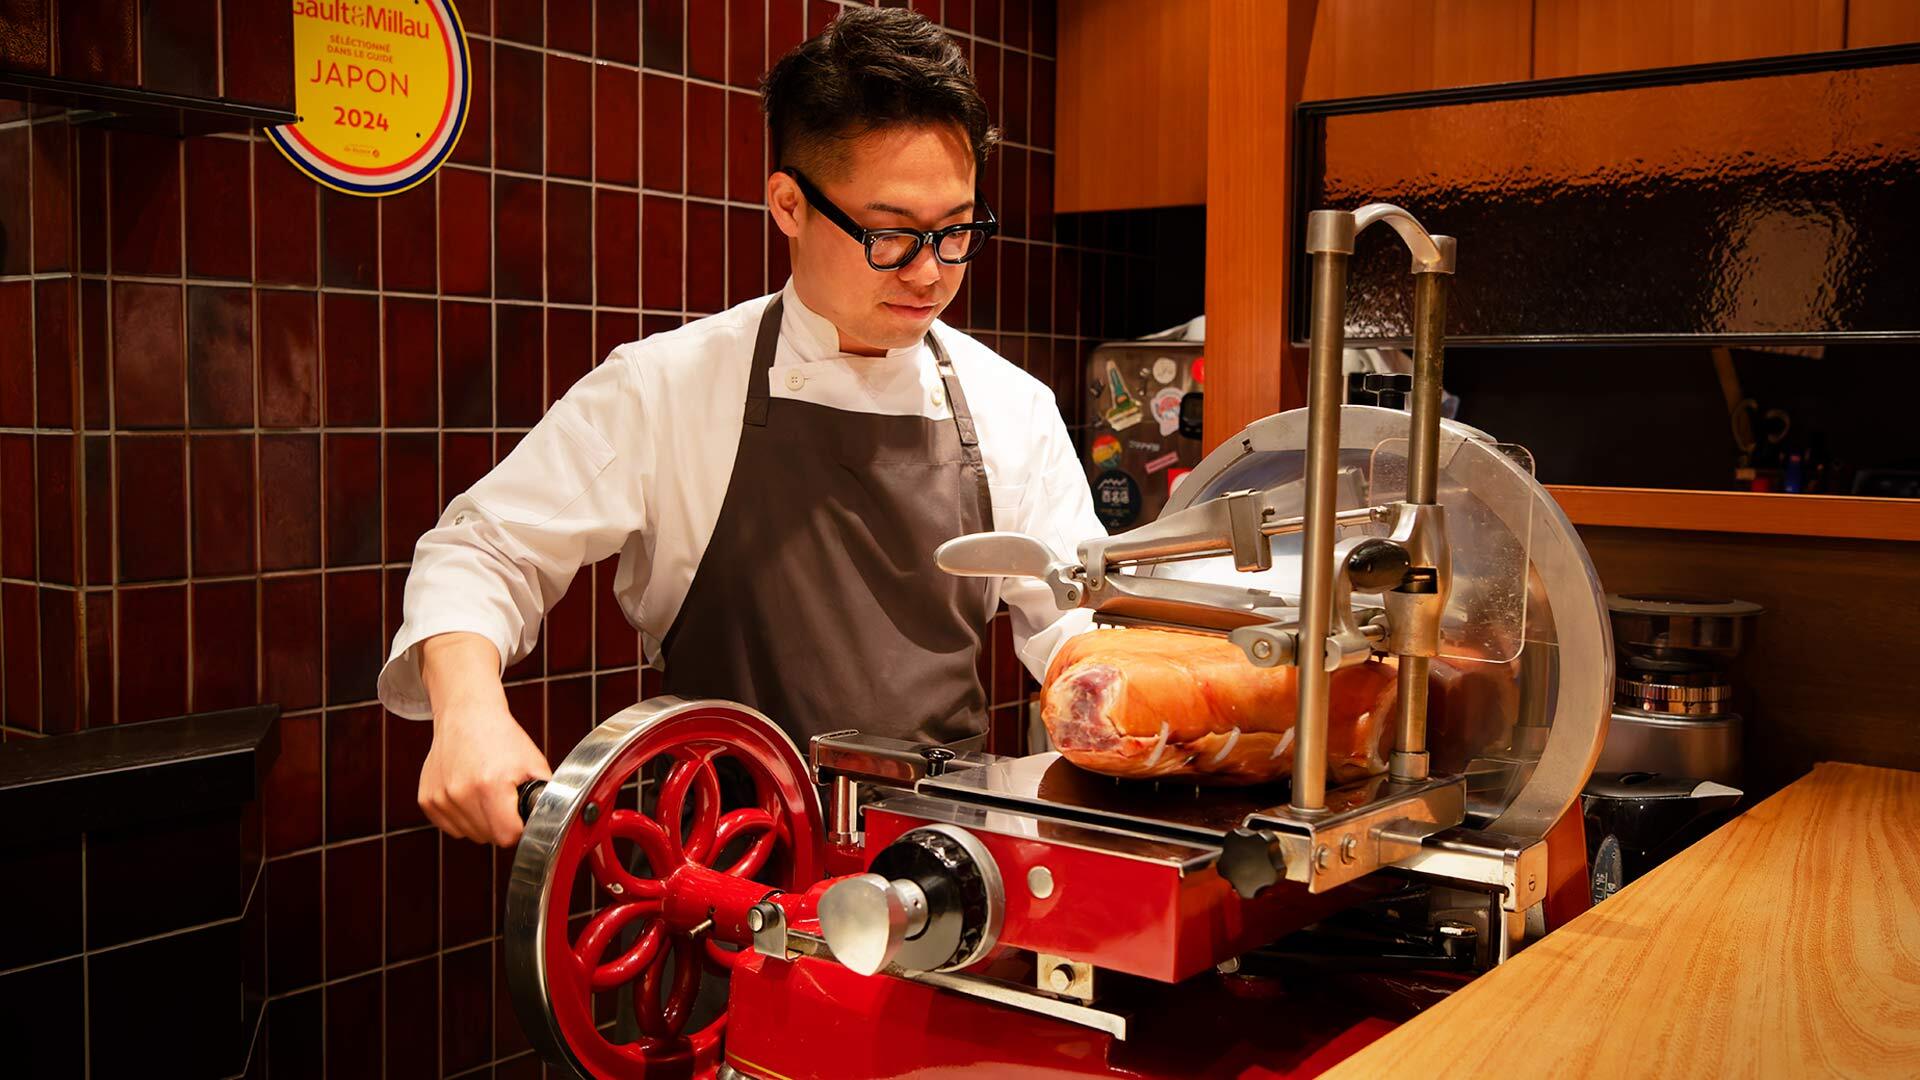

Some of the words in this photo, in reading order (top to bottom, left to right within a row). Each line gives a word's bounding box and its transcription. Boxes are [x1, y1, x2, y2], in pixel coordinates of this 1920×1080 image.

[327, 44, 352, 56] DANS
[354, 49, 364, 58] LE
[366, 52, 393, 64] GUIDE
[310, 59, 408, 97] JAPON
[333, 106, 389, 131] 2024
